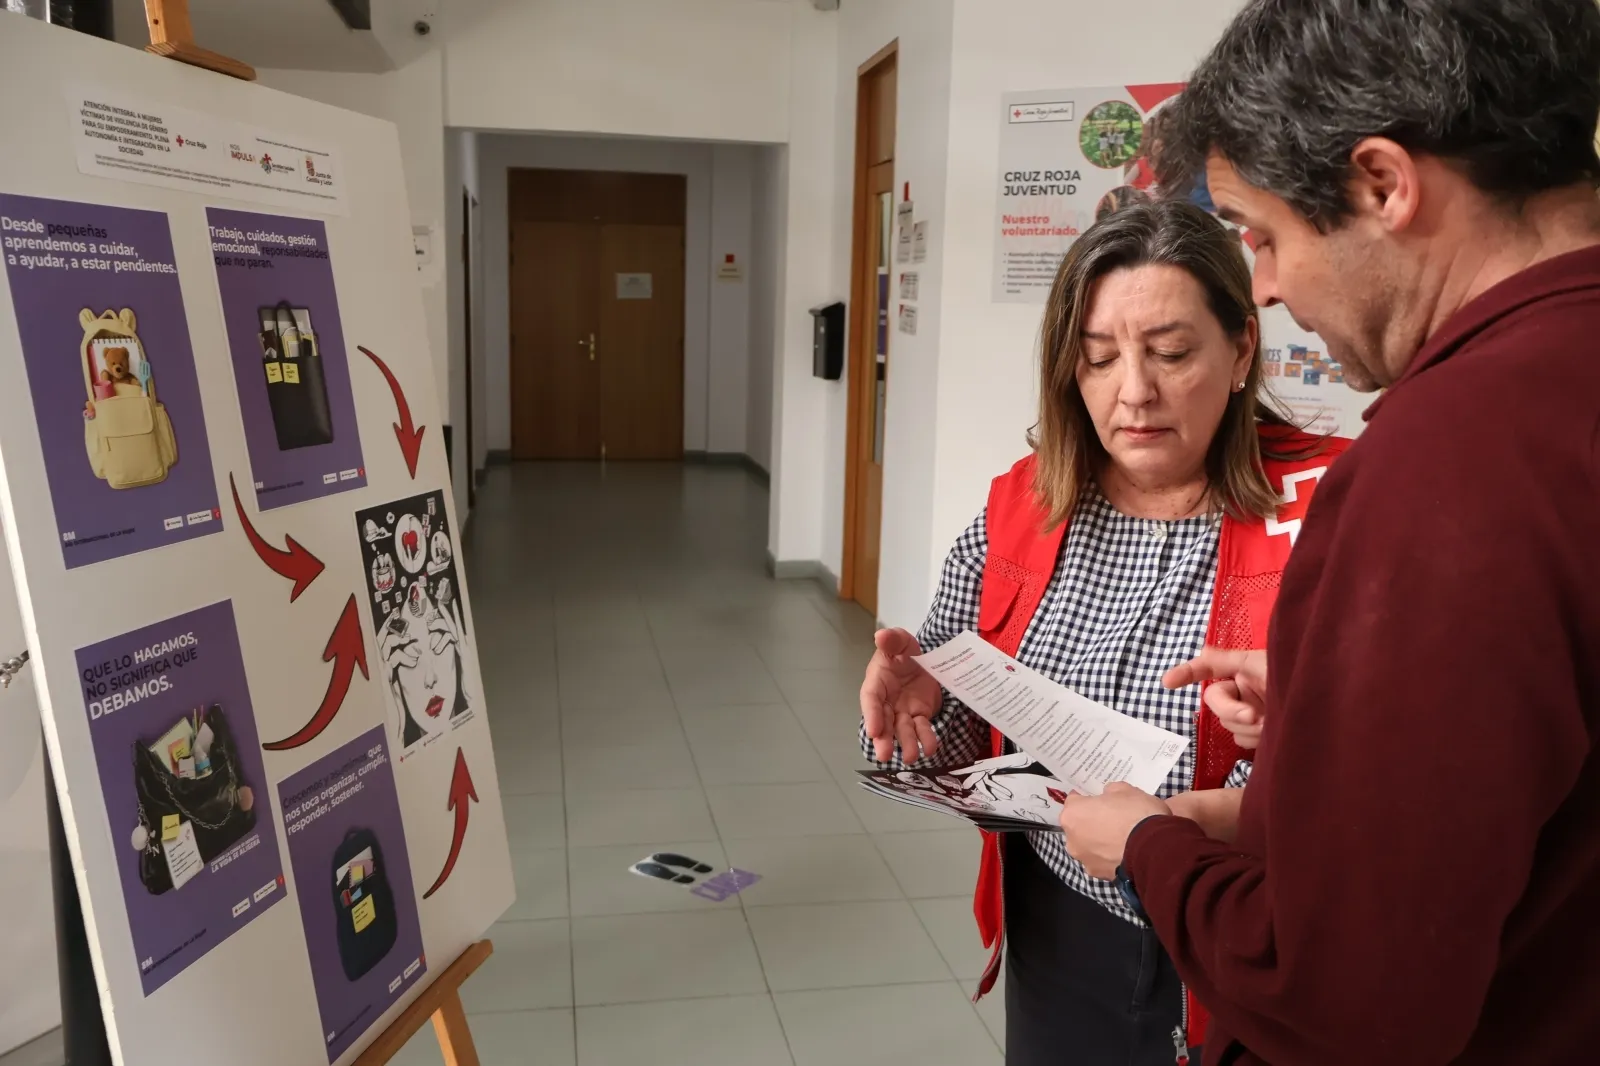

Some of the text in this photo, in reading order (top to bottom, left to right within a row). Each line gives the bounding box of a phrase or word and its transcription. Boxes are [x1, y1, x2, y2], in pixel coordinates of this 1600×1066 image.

[80, 109, 105, 120] VÍCTIMAS
[113, 117, 141, 129] VIOLENCIA
[141, 122, 148, 130] DE
[148, 124, 168, 135] GÉNERO
[83, 100, 112, 112] ATENCIÓN
[111, 106, 136, 118] INTEGRAL
[141, 113, 163, 124] MUJERES
[81, 119, 97, 128] PARA
[97, 122, 105, 130] SU
[84, 129, 118, 143] AUTONOMÍA
[122, 137, 157, 150] INTEGRACIÓN
[185, 139, 207, 149] Cruz Roja
[118, 145, 144, 156] SOCIEDAD
[1004, 169, 1082, 183] CRUZ ROJA
[1003, 184, 1077, 196] JUVENTUD
[1, 216, 108, 239] Desde pequeñas
[1002, 215, 1050, 225] Nuestro
[209, 226, 317, 247] Trabajo, cuidados, gestión
[1002, 225, 1081, 237] voluntariado.
[4, 236, 139, 258] aprendemos a cuidar,
[212, 240, 261, 256] emocional,
[8, 252, 178, 274] a ayudar, a estar pendientes.
[215, 256, 233, 268] que
[234, 257, 246, 267] no
[83, 631, 198, 683] QUE LO HAGAMOS,
[86, 647, 198, 700] NO SIGNIFICA QUE
[89, 675, 173, 720] DEBAMOS.
[367, 744, 382, 758] que
[285, 807, 301, 823] nos
[301, 795, 320, 813] toca
[320, 772, 358, 800] organizar,
[358, 753, 387, 777] cumplir,
[287, 781, 365, 836] responder, sostener.
